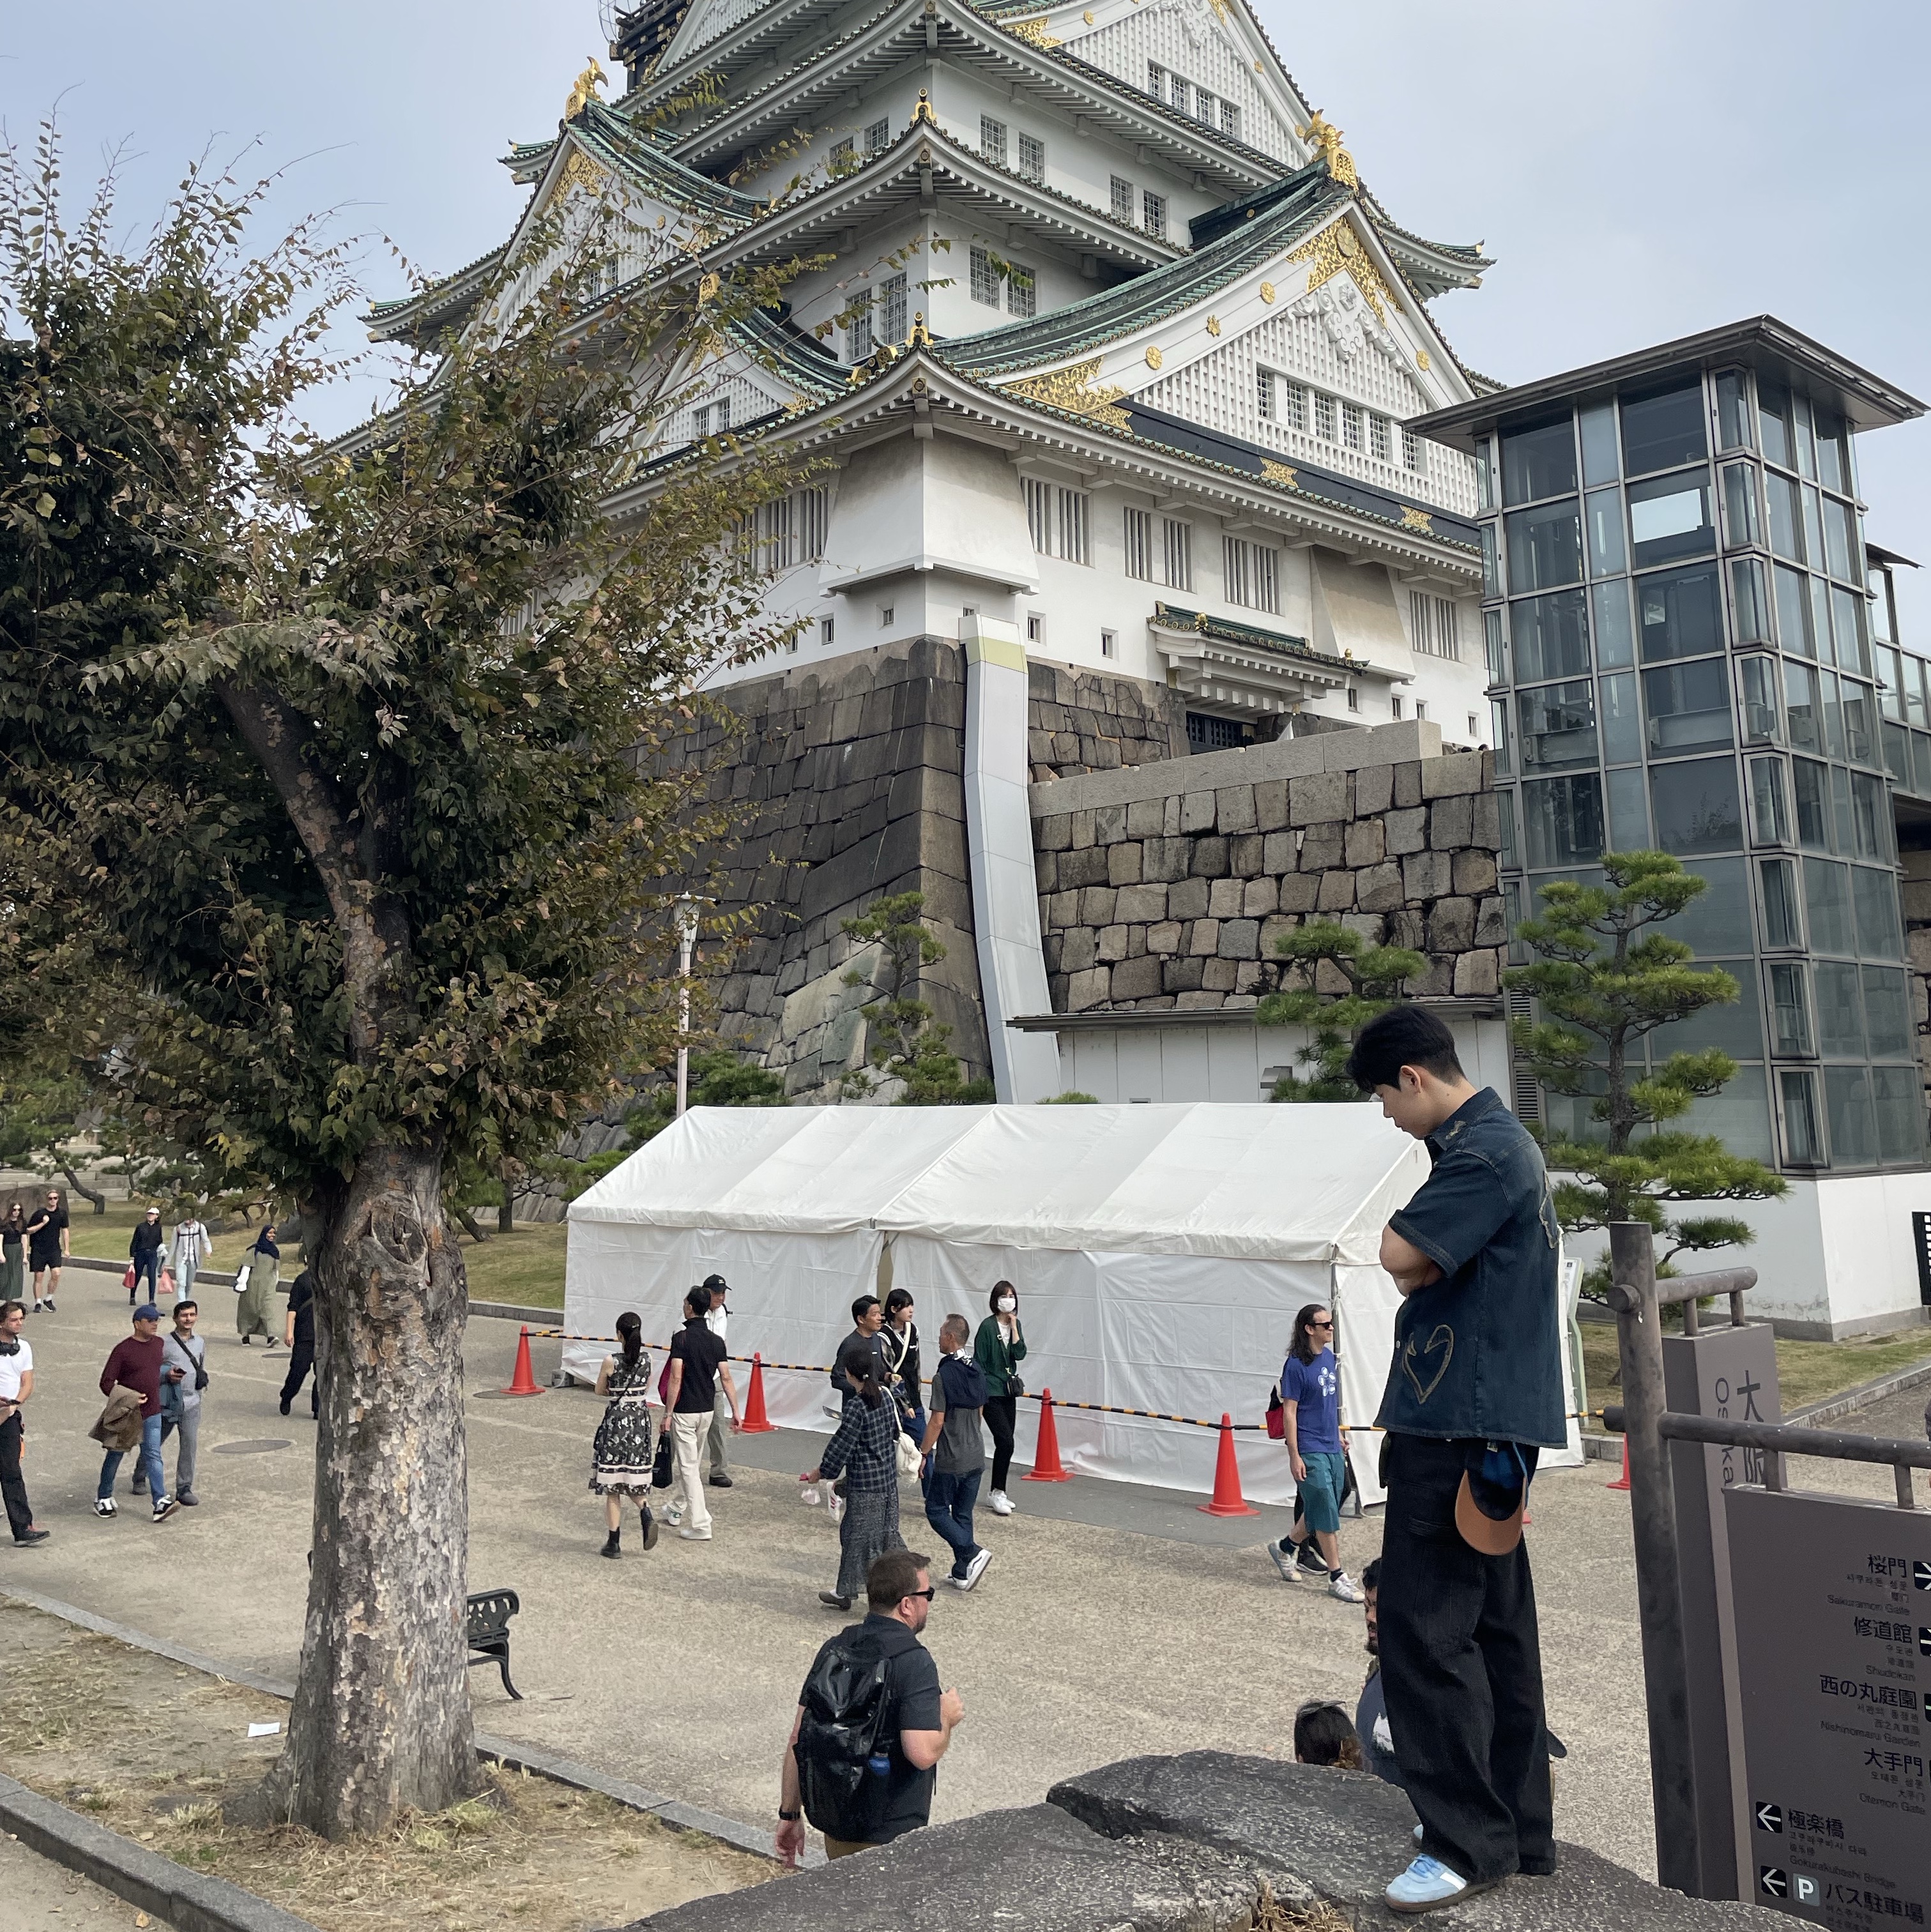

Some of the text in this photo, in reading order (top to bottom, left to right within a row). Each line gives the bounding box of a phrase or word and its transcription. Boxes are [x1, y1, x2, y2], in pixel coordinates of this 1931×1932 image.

[1867, 1554, 1907, 1578] 桜門
[1854, 1616, 1912, 1645] 修道館
[1820, 1674, 1917, 1711] 西の丸庭園
[1883, 1732, 1921, 1748] Garden
[1864, 1747, 1923, 1777] 大手門
[1788, 1808, 1844, 1839] 極楽橋
[1797, 1877, 1813, 1900] P
[1826, 1883, 1925, 1925] バス駐車場
